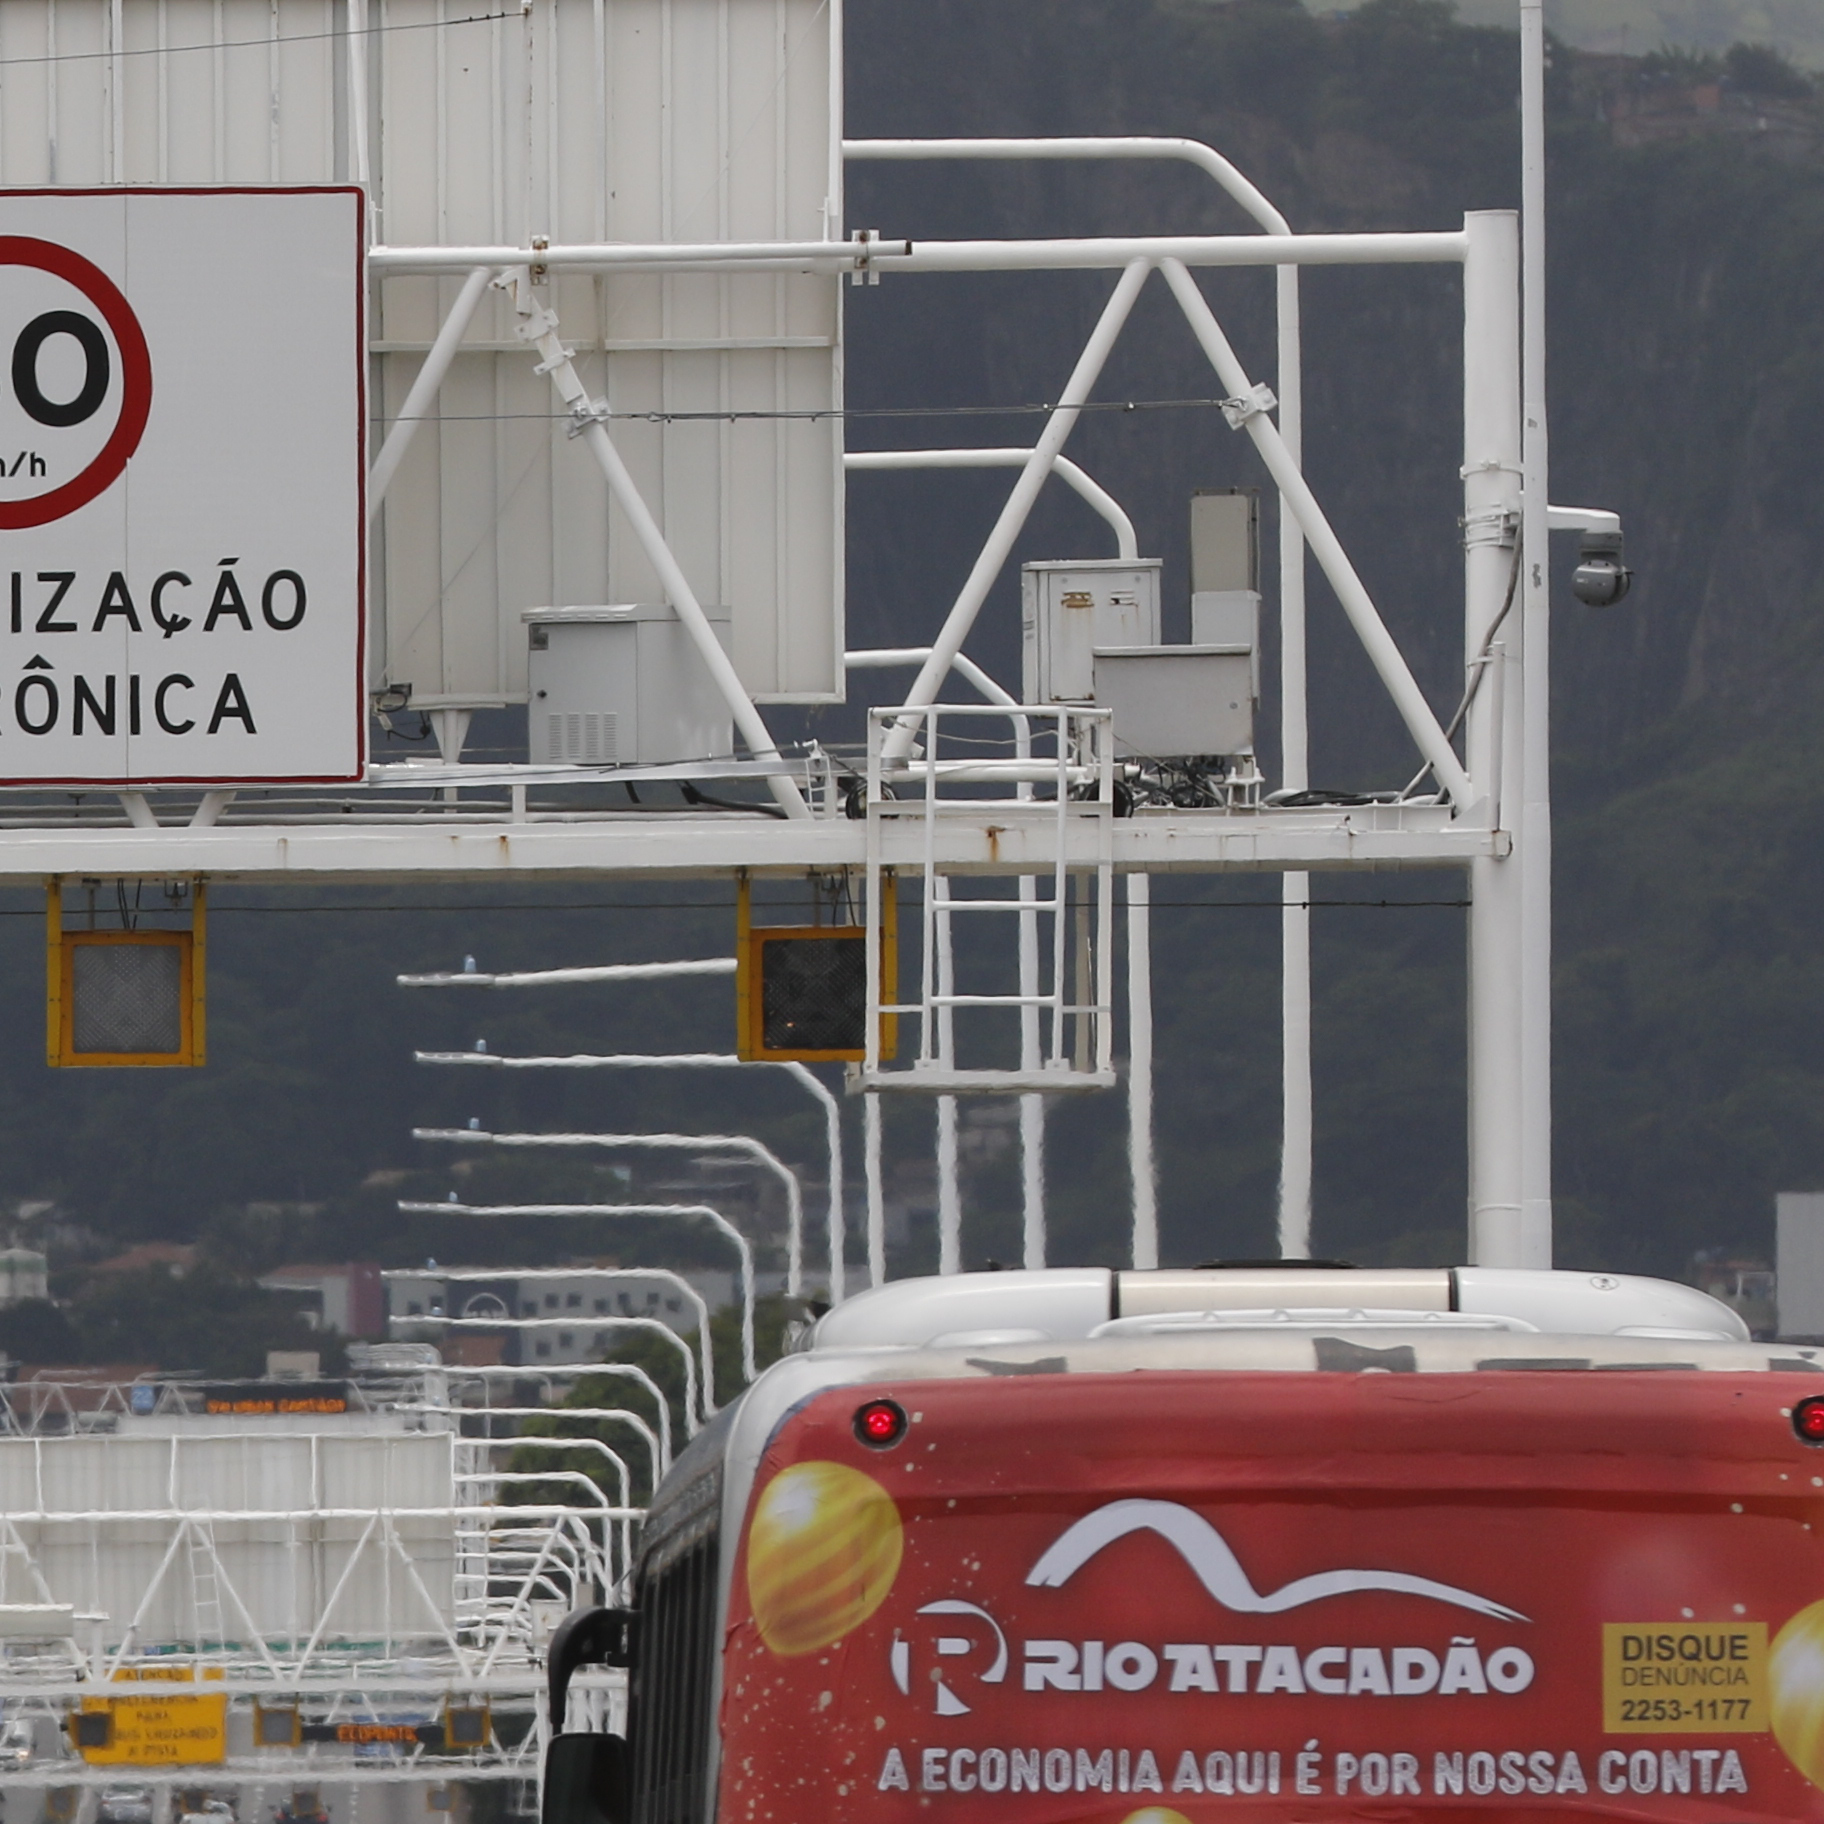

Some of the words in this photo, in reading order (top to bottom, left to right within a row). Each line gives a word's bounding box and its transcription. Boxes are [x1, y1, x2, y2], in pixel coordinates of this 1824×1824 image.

[1622, 1635, 1749, 1662] DISQUE
[1023, 1638, 1159, 1692] RIO
[1163, 1635, 1535, 1696] ATACADÃO
[1622, 1662, 1749, 1686] DENÚNCIA
[1621, 1699, 1751, 1721] 2253-1177
[877, 1746, 909, 1792] A
[922, 1747, 1163, 1794] ECONOMIA
[1173, 1750, 1281, 1796] AQUI
[1295, 1738, 1322, 1796] É
[1336, 1751, 1420, 1796] POR
[1434, 1750, 1583, 1796] NOSSA
[1598, 1748, 1747, 1796] CONTA
